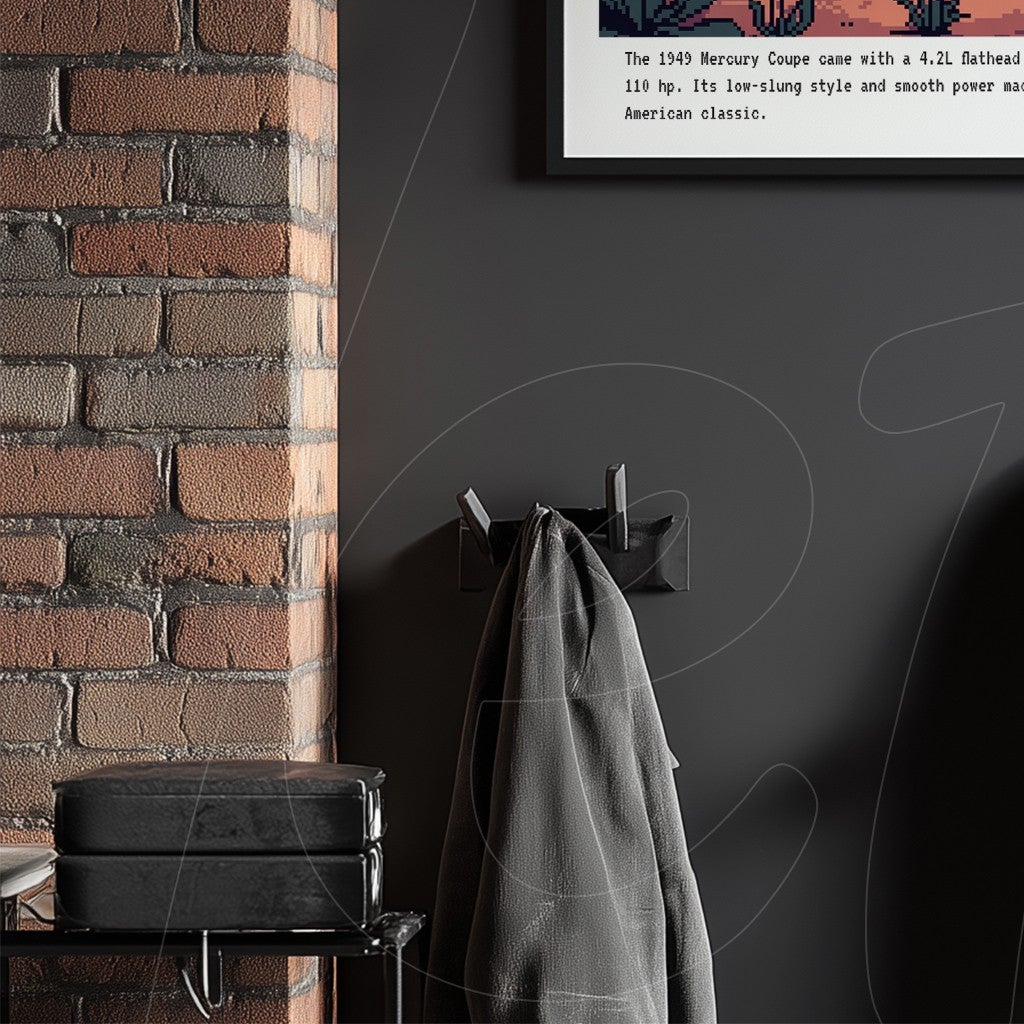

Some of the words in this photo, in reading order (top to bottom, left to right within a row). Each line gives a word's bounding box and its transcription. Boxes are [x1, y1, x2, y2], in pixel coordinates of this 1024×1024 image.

[624, 51, 650, 66] The
[659, 51, 692, 66] 1949
[700, 51, 760, 69] Mercury
[767, 51, 810, 69] Coupe
[818, 54, 852, 66] came
[860, 50, 894, 66] with
[902, 54, 911, 66] a
[919, 50, 953, 66] 4.2L
[961, 50, 1021, 66] flathead
[625, 78, 650, 93] 110
[658, 78, 682, 97] hp.
[693, 78, 717, 93] Its
[726, 78, 802, 97] low-slung
[810, 78, 852, 97] style
[860, 78, 886, 93] and
[894, 78, 945, 93] smooth
[952, 81, 995, 96] power
[624, 106, 692, 120] American
[700, 106, 766, 120] classic.
